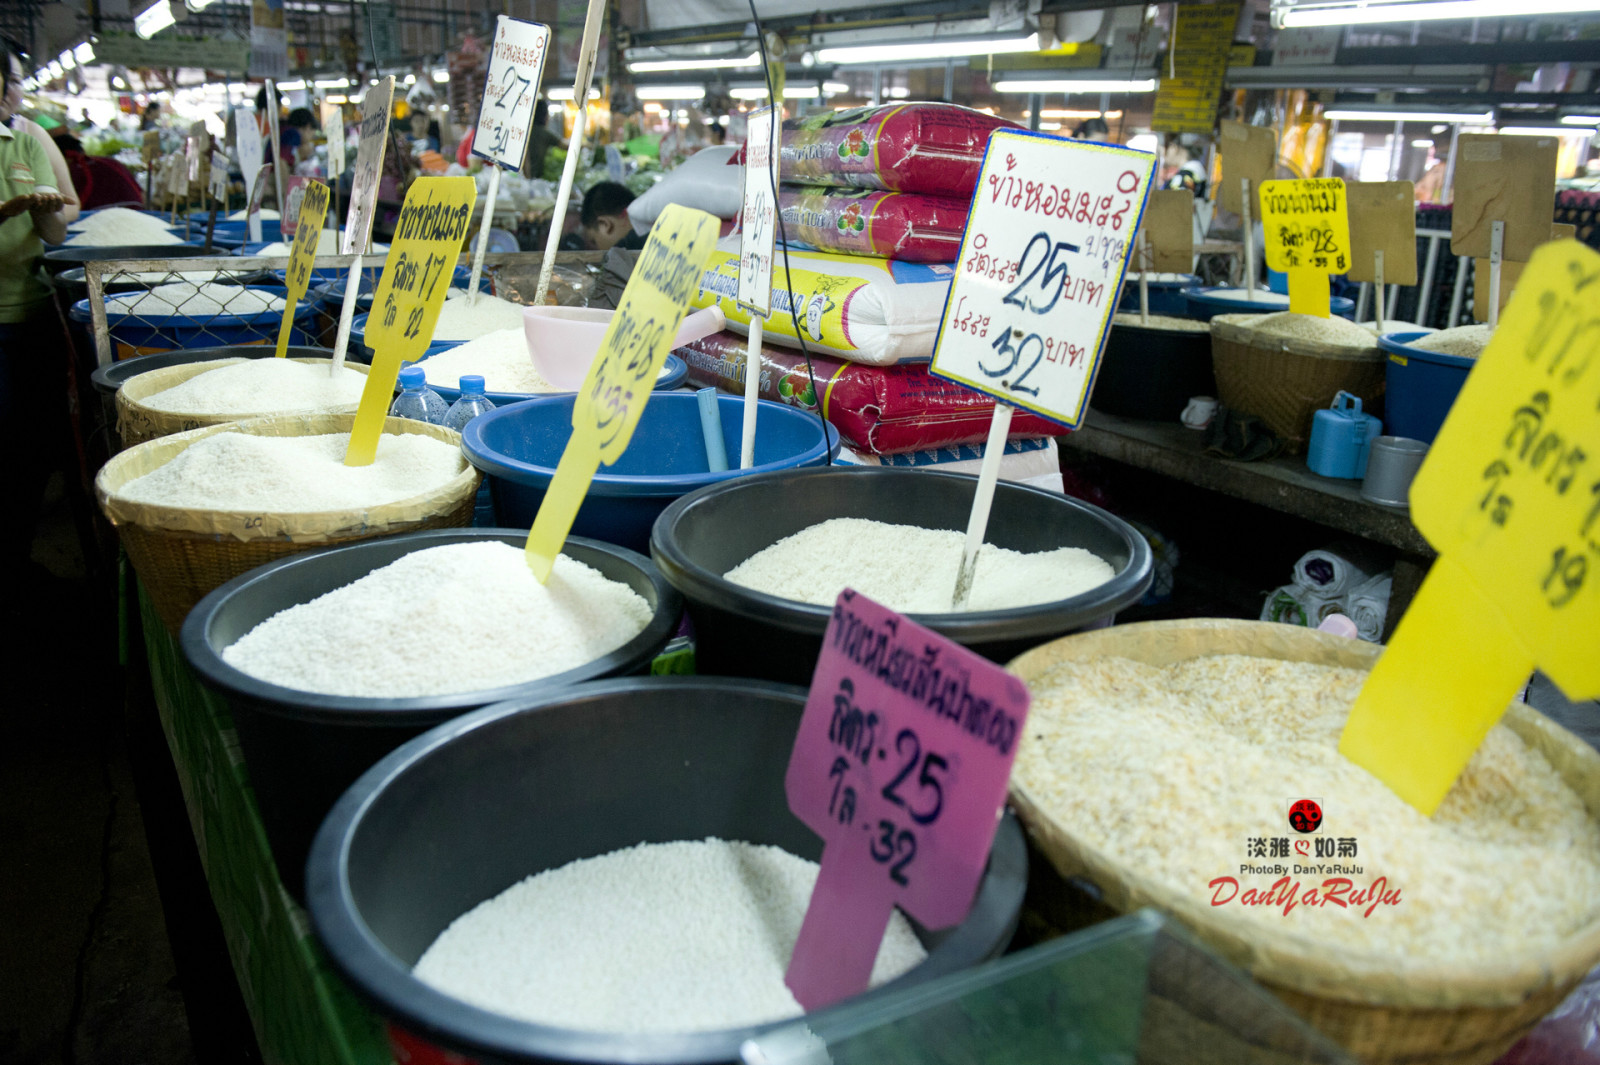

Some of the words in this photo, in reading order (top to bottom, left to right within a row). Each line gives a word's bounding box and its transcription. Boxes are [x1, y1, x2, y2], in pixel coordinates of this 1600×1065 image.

[494, 65, 531, 118] 27
[1310, 228, 1339, 254] 28
[417, 251, 447, 302] 17
[1002, 231, 1081, 315] 25
[1063, 273, 1104, 308] บาท
[403, 306, 424, 341] 22
[978, 325, 1045, 398] 32
[1538, 542, 1590, 612] 19
[881, 728, 949, 826] 25
